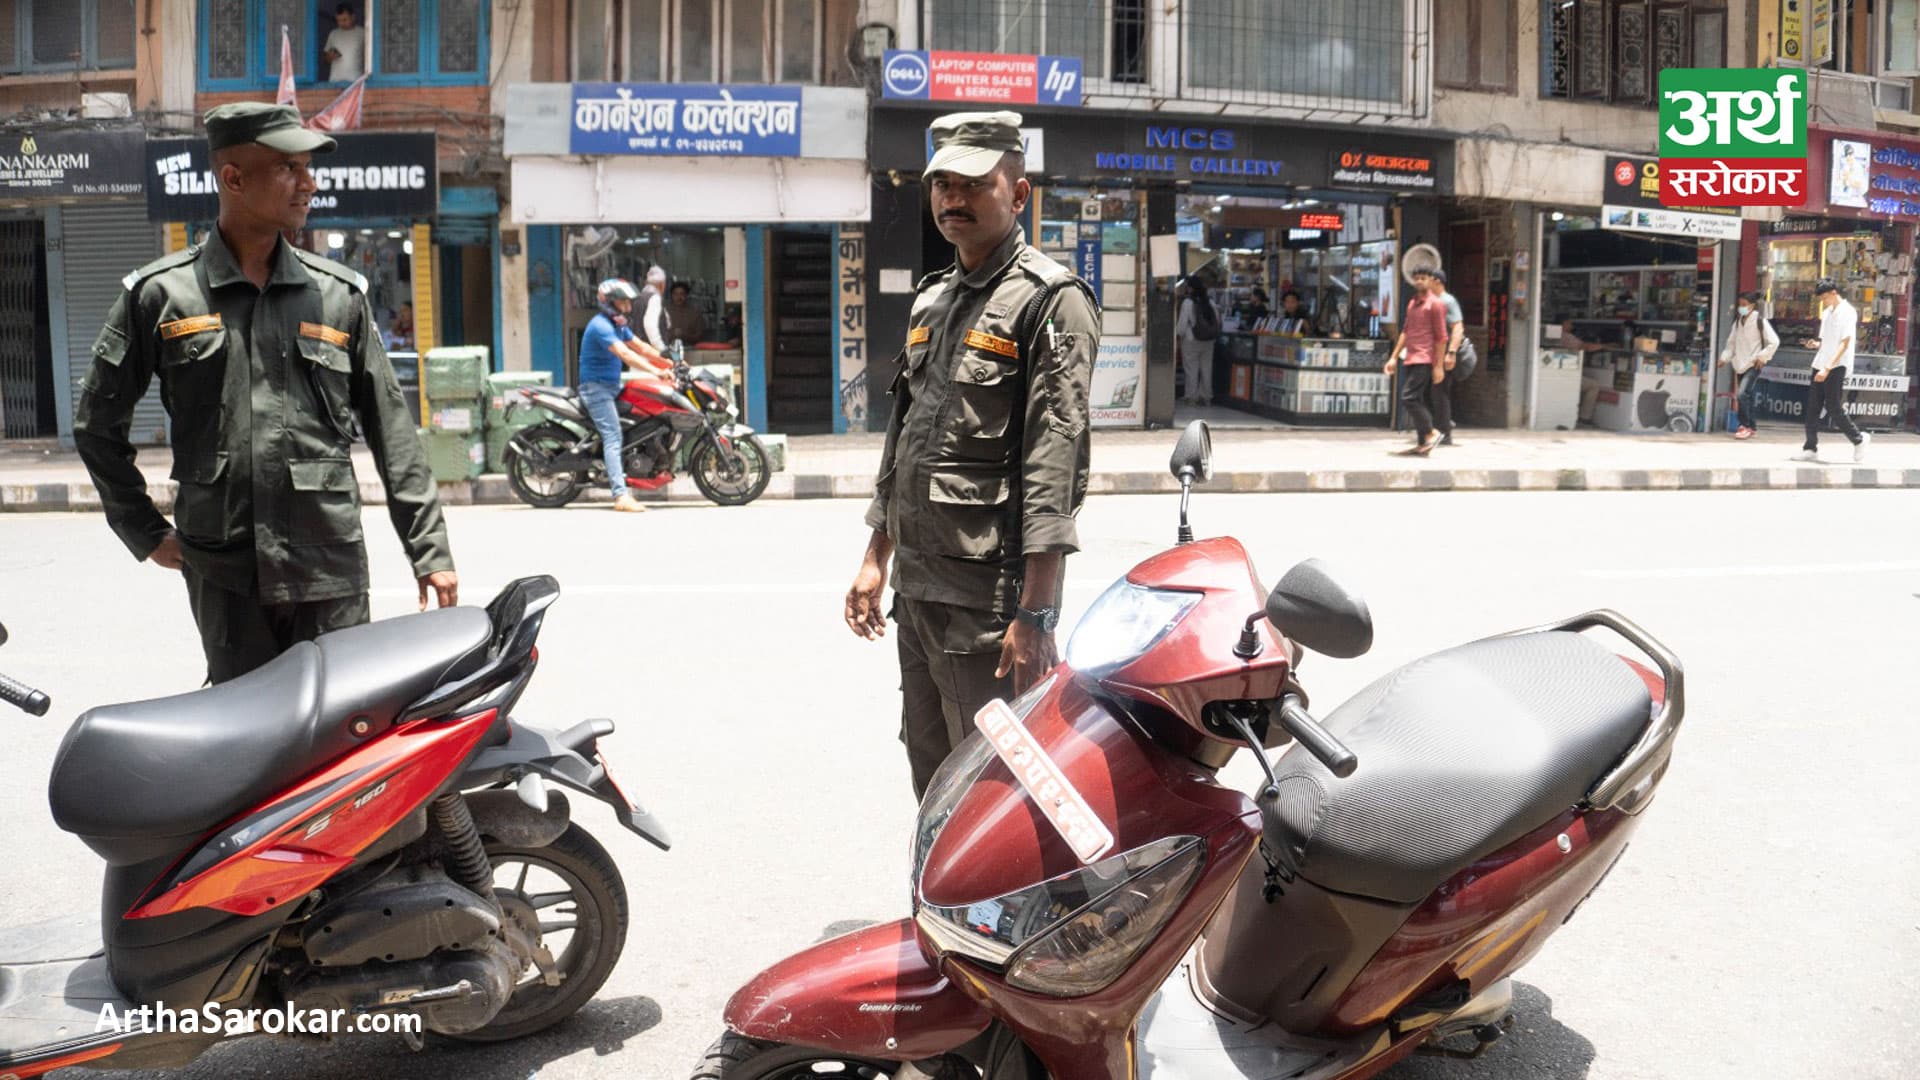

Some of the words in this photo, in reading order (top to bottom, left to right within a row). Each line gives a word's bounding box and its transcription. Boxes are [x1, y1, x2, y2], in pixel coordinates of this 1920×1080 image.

[890, 67, 923, 80] DELL
[932, 60, 976, 71] LAPTOP
[976, 61, 1036, 73] COMPUTER
[936, 73, 989, 85] PRINTER
[992, 75, 1033, 87] SALES
[1044, 60, 1076, 101] hp
[955, 87, 963, 97] &
[965, 87, 1011, 98] SERVICE
[682, 89, 799, 137] कलेक्शन
[1146, 126, 1235, 150] MCS
[0, 153, 89, 169] NANKARMI
[156, 152, 191, 176] NEW
[1096, 152, 1176, 171] MOBILE
[1190, 157, 1283, 176] GALLERY
[1341, 152, 1362, 168] 0%
[24, 169, 64, 179] JEWELLERS
[72, 184, 84, 193] Tel
[309, 196, 338, 208] OAD
[1774, 219, 1817, 233] SAMSUNG
[1098, 344, 1144, 355] mputer
[1843, 377, 1898, 389] SAMSUNG
[1842, 401, 1898, 416] SAMSUNG
